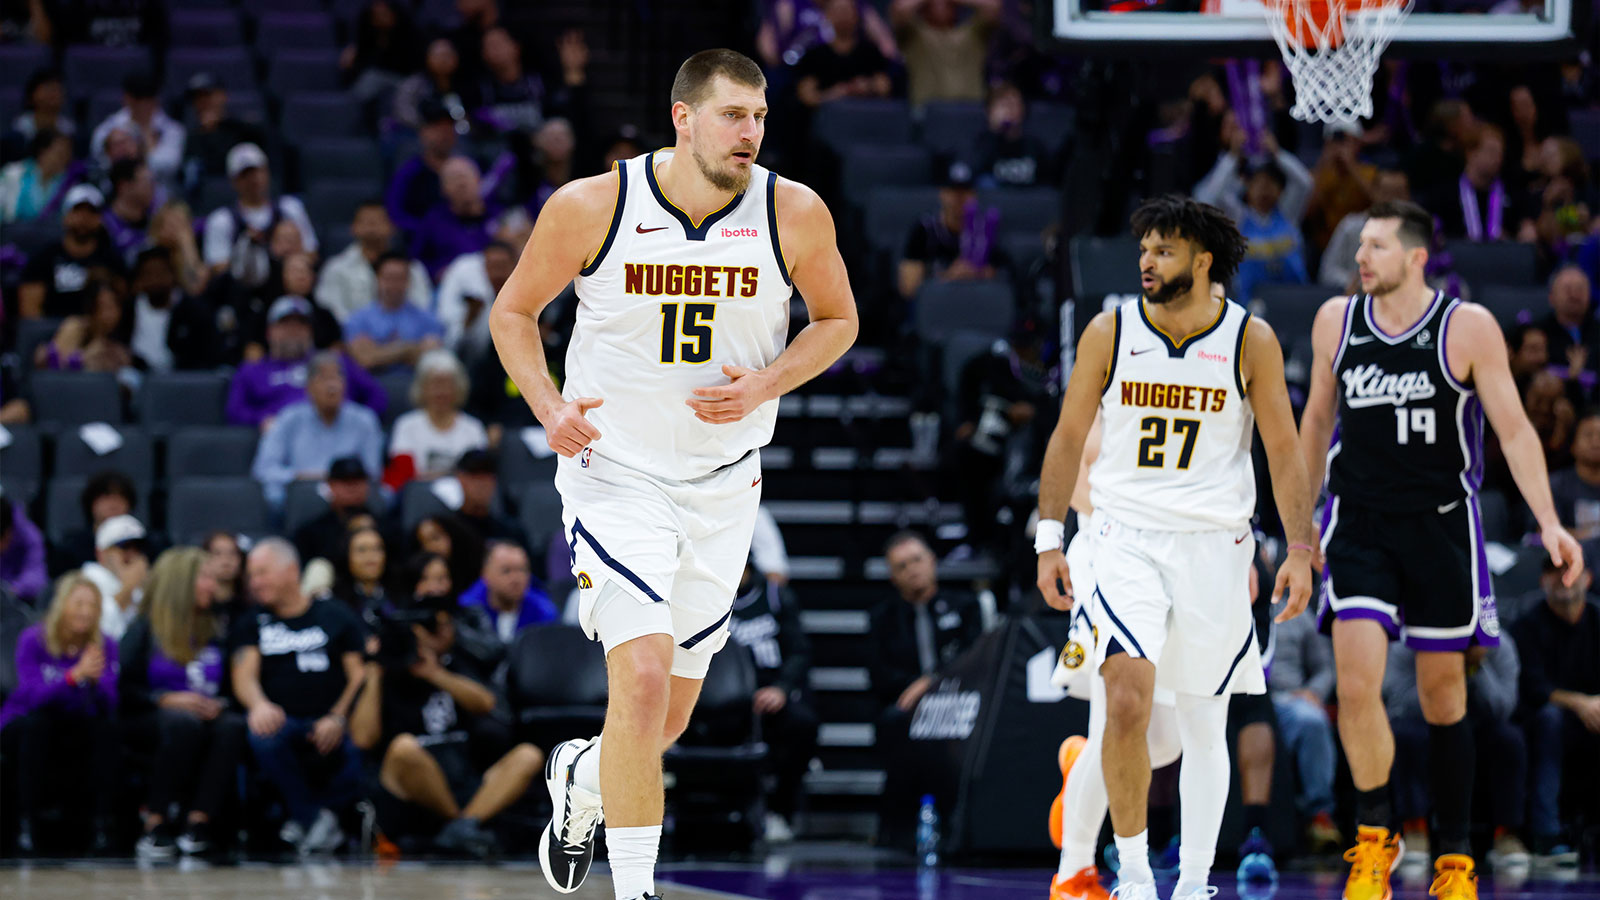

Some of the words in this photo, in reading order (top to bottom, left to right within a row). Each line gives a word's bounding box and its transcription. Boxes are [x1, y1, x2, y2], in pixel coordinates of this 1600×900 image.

[721, 228, 758, 238] ibotta
[624, 263, 759, 298] NUGGETS
[660, 302, 717, 365] 15
[1198, 350, 1228, 363] ibotta
[1121, 381, 1228, 413] NUGGETS
[1342, 363, 1437, 409] Kings
[1137, 416, 1202, 470] 27
[1395, 407, 1437, 445] 19
